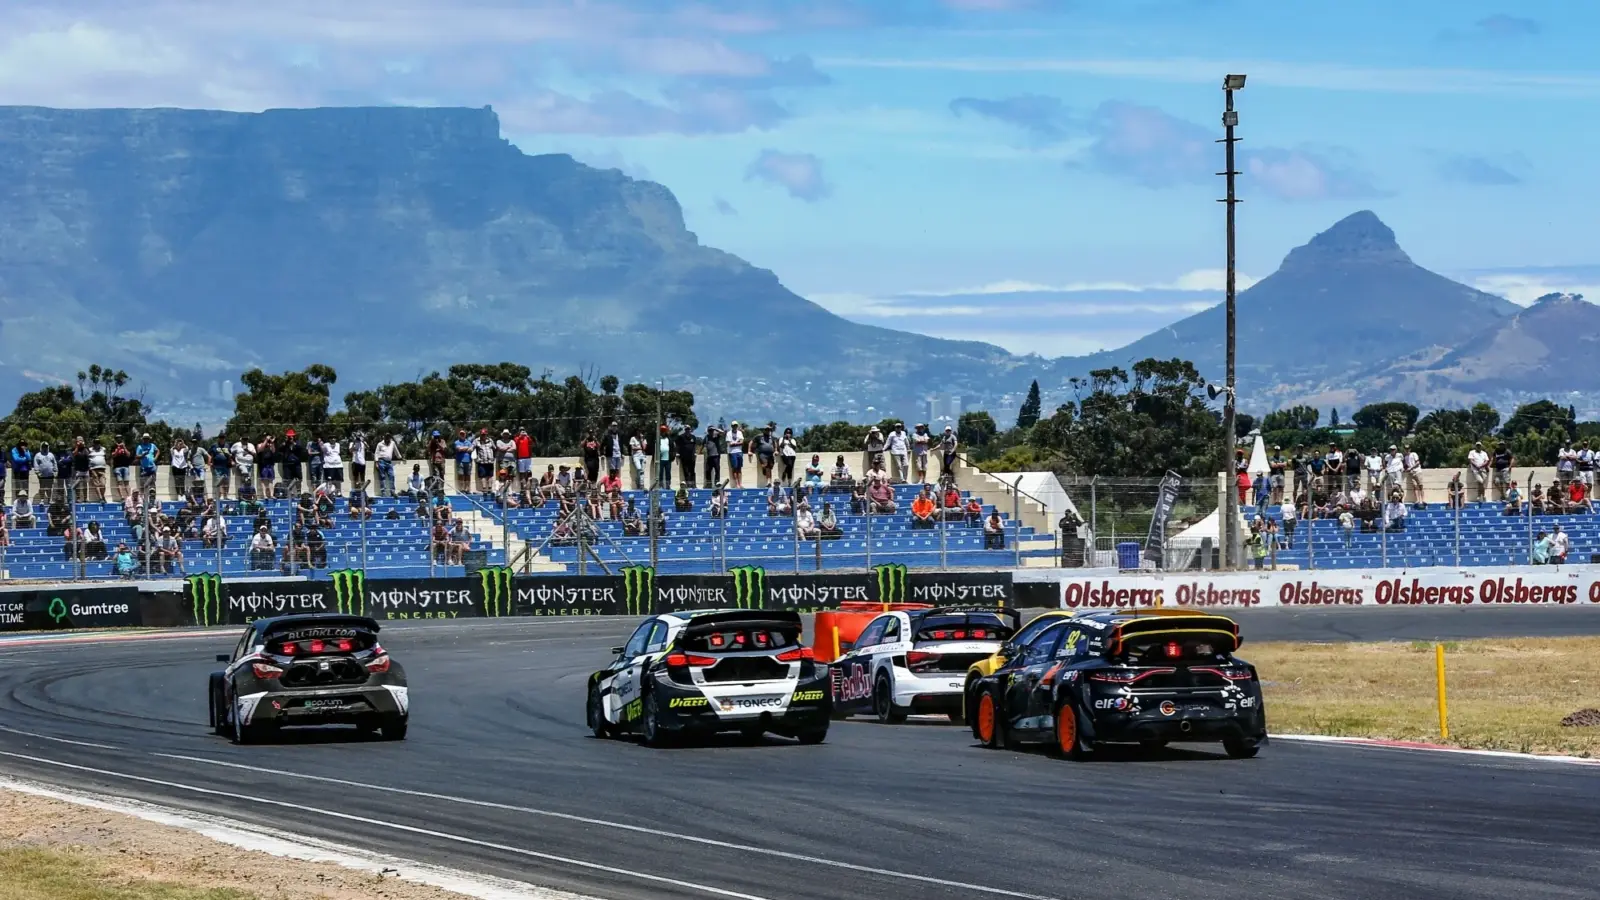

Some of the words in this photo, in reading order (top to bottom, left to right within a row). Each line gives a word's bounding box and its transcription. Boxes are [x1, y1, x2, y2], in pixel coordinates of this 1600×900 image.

[72, 603, 128, 616] Gumtree
[736, 698, 782, 708] TONECO
[1095, 698, 1114, 709] elf
